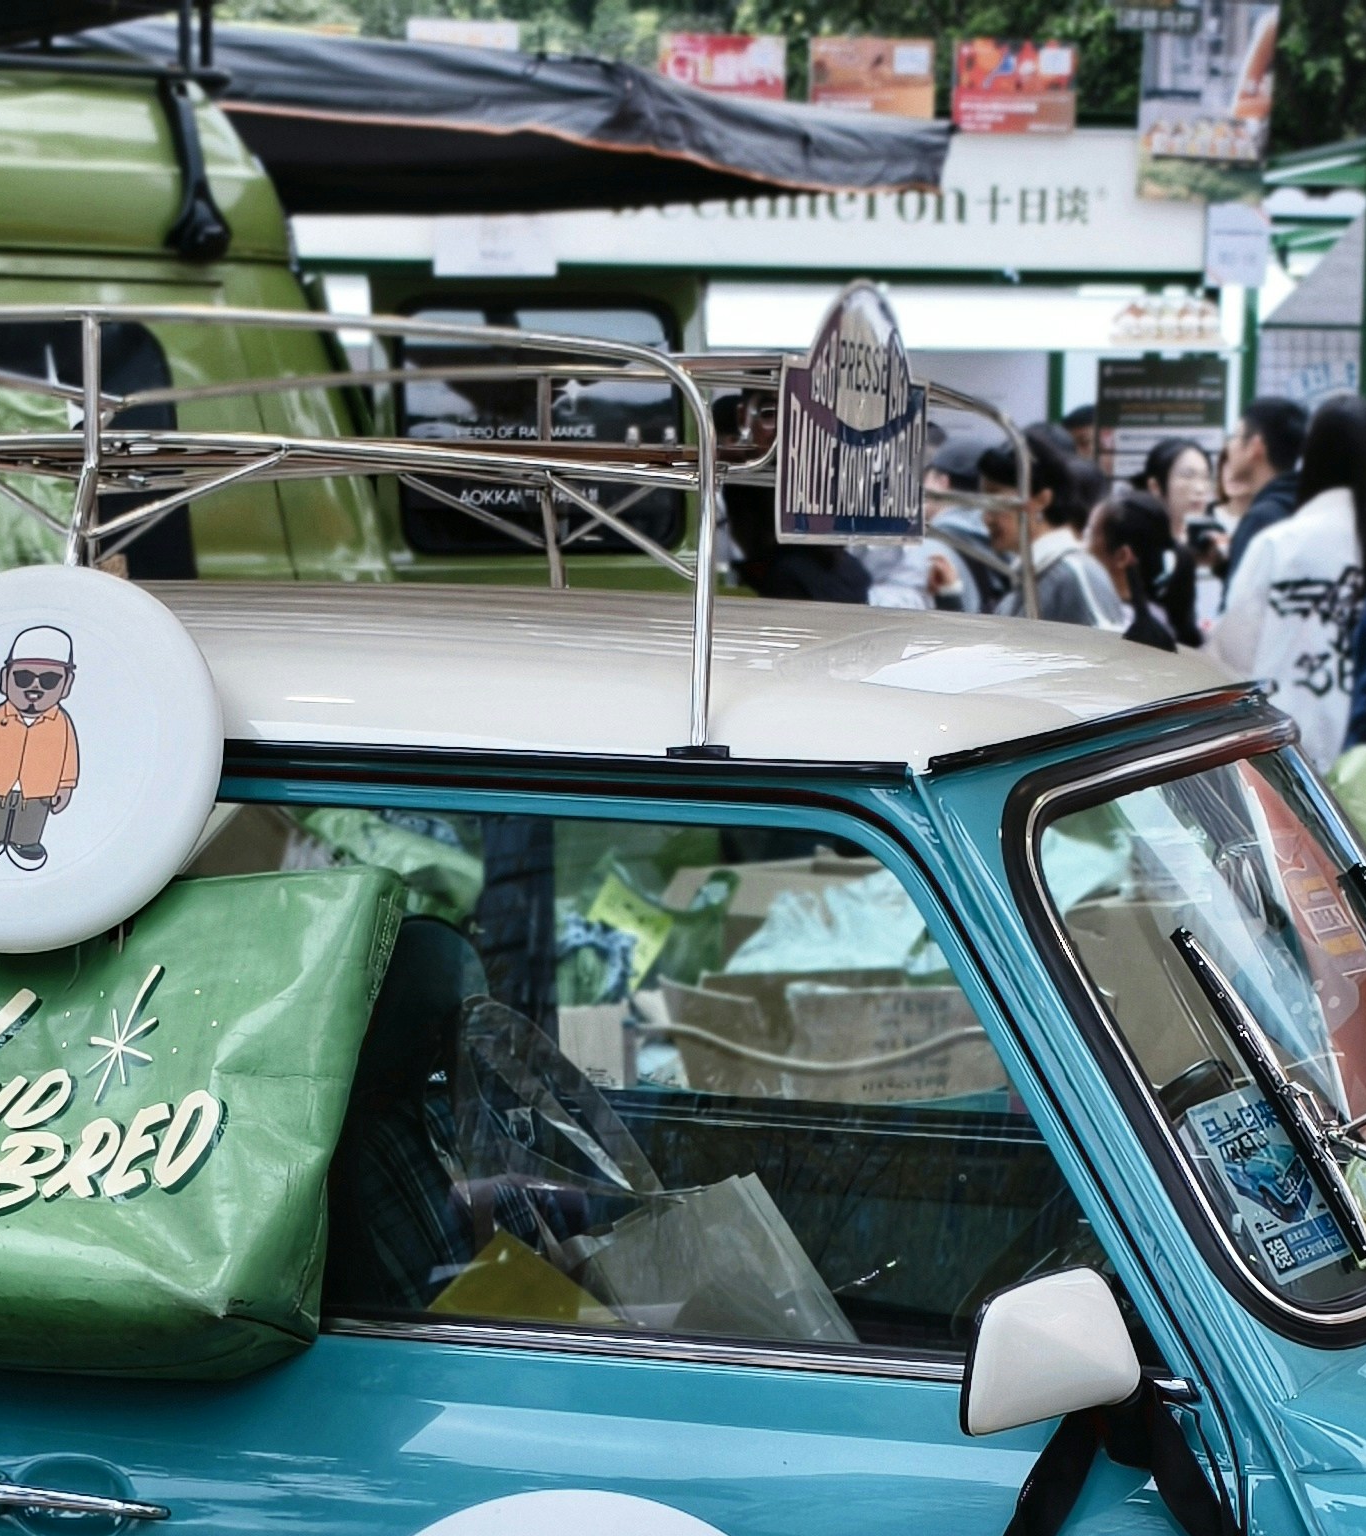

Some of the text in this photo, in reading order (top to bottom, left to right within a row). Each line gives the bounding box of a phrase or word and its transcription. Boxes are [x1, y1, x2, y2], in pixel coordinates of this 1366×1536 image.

[611, 184, 1089, 225] ameron 十日谈
[840, 339, 887, 397] PRESSE
[786, 391, 837, 515] RALLYE
[458, 488, 520, 505] AOKKA
